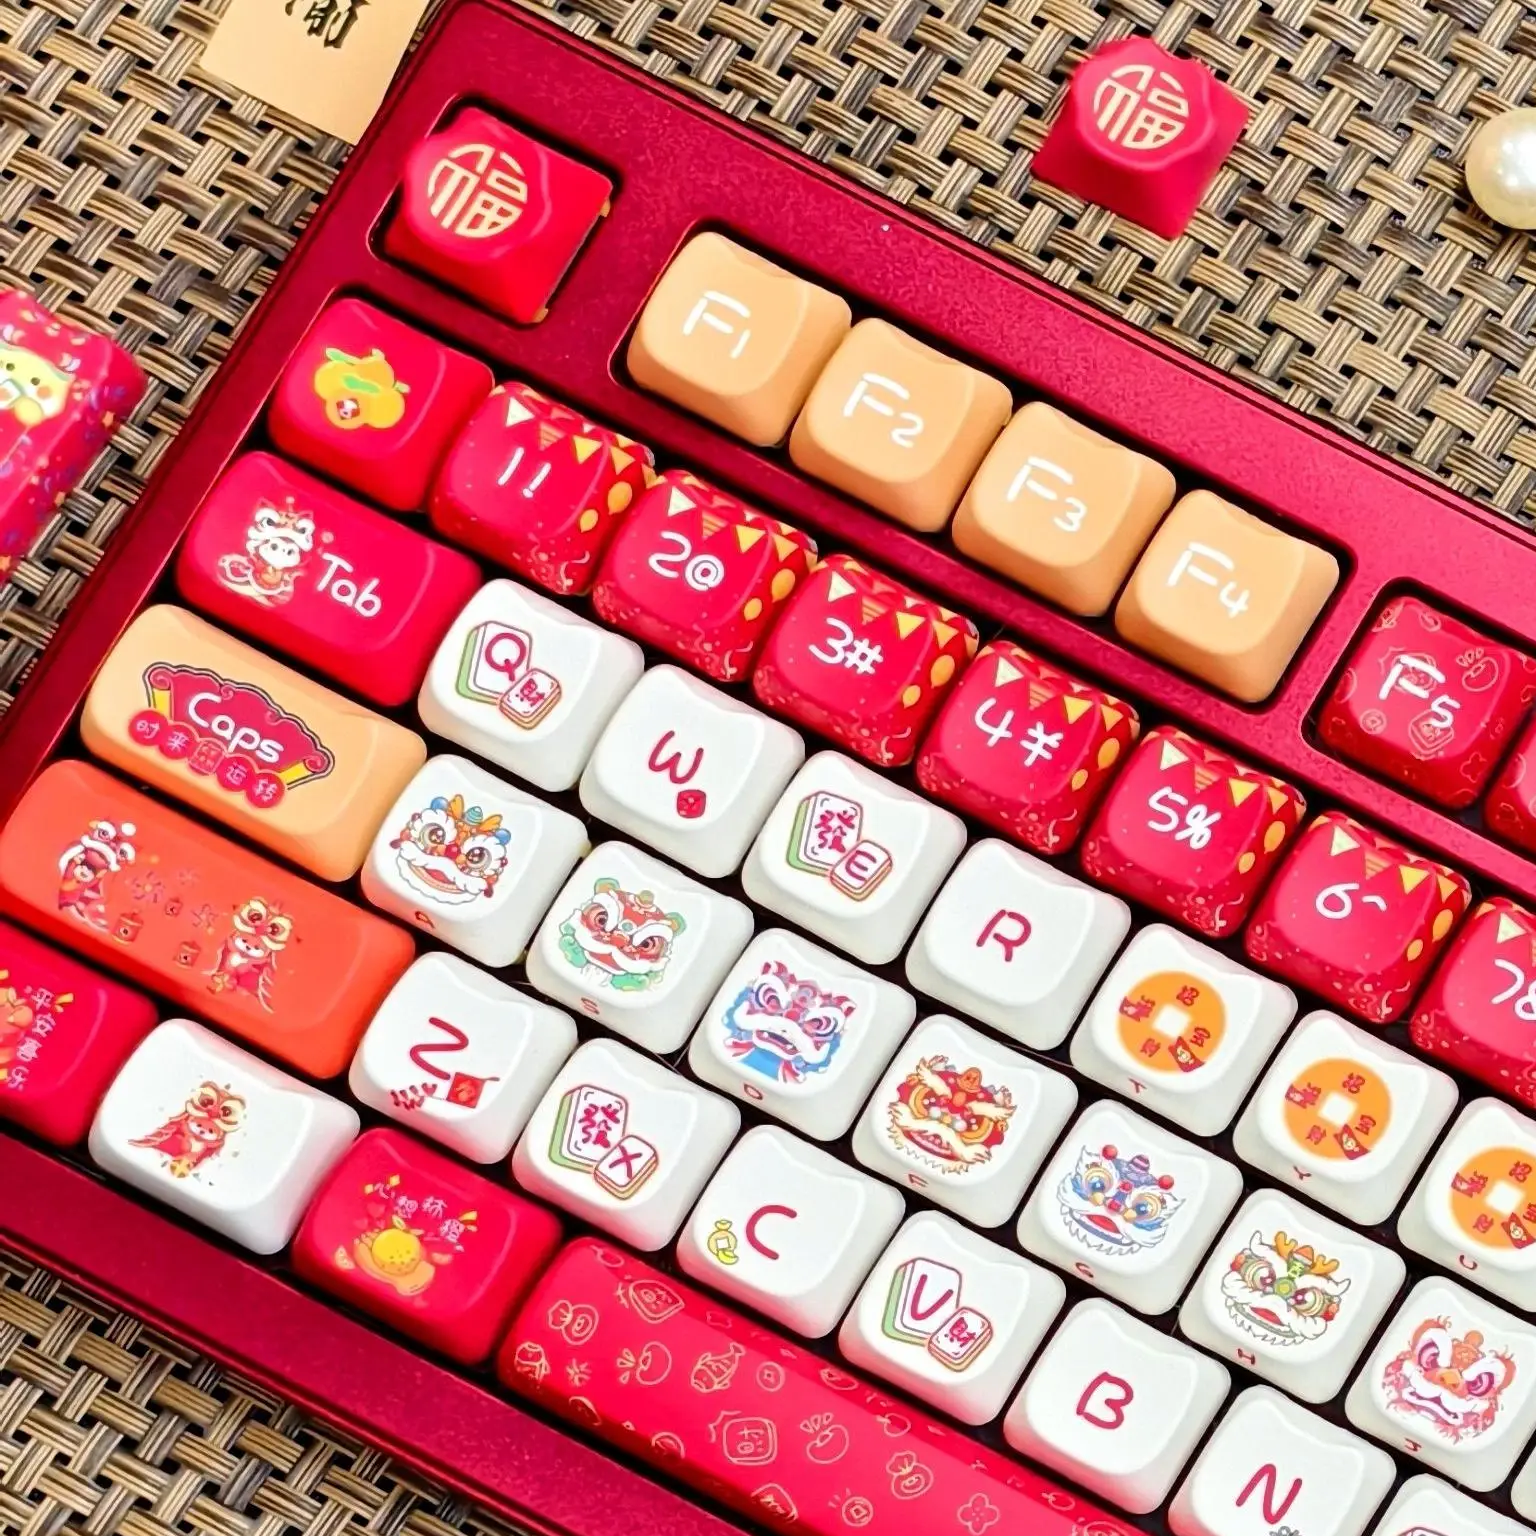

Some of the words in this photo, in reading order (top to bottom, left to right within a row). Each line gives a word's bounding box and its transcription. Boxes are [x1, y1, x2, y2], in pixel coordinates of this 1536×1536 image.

[1093, 64, 1189, 150] 福
[428, 143, 528, 238] 福
[683, 291, 751, 359] F1
[842, 372, 924, 447] F2
[1005, 456, 1088, 533] F3
[320, 551, 381, 618] Tab
[1166, 542, 1249, 619] F4
[485, 633, 527, 681] Q
[1380, 655, 1461, 729] F5
[186, 692, 285, 763] Caps
[649, 731, 704, 784] W
[846, 850, 878, 880] E
[976, 909, 1032, 962] R
[409, 1017, 470, 1081] Z
[609, 1146, 642, 1179] X
[745, 1205, 797, 1260] C
[910, 1274, 954, 1321] V
[1076, 1372, 1133, 1429] B
[1235, 1463, 1302, 1525] N
